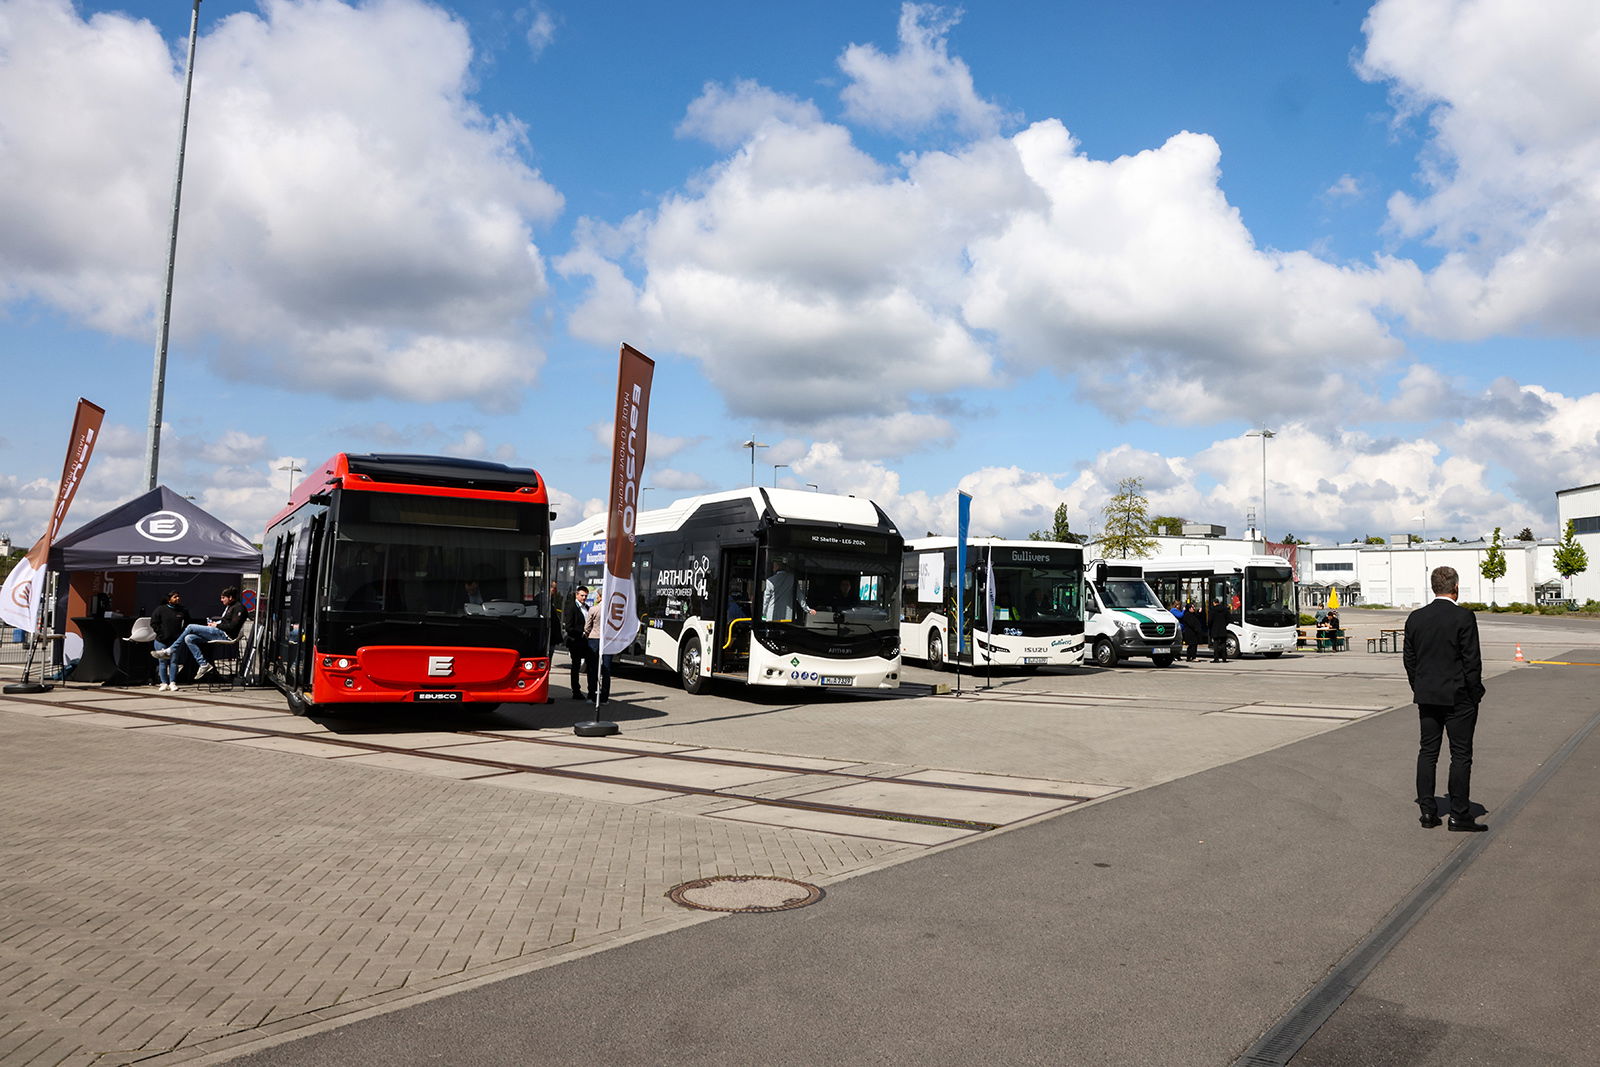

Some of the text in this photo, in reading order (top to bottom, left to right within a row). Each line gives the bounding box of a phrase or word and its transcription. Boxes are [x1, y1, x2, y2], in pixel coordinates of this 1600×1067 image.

[620, 425, 627, 438] TO
[623, 383, 641, 534] EBUSCO
[617, 473, 625, 517] PEOPLE
[117, 554, 206, 567] EBUSCO
[1011, 550, 1051, 562] Gullivers
[656, 569, 693, 586] ARTHUR
[428, 655, 455, 676] E
